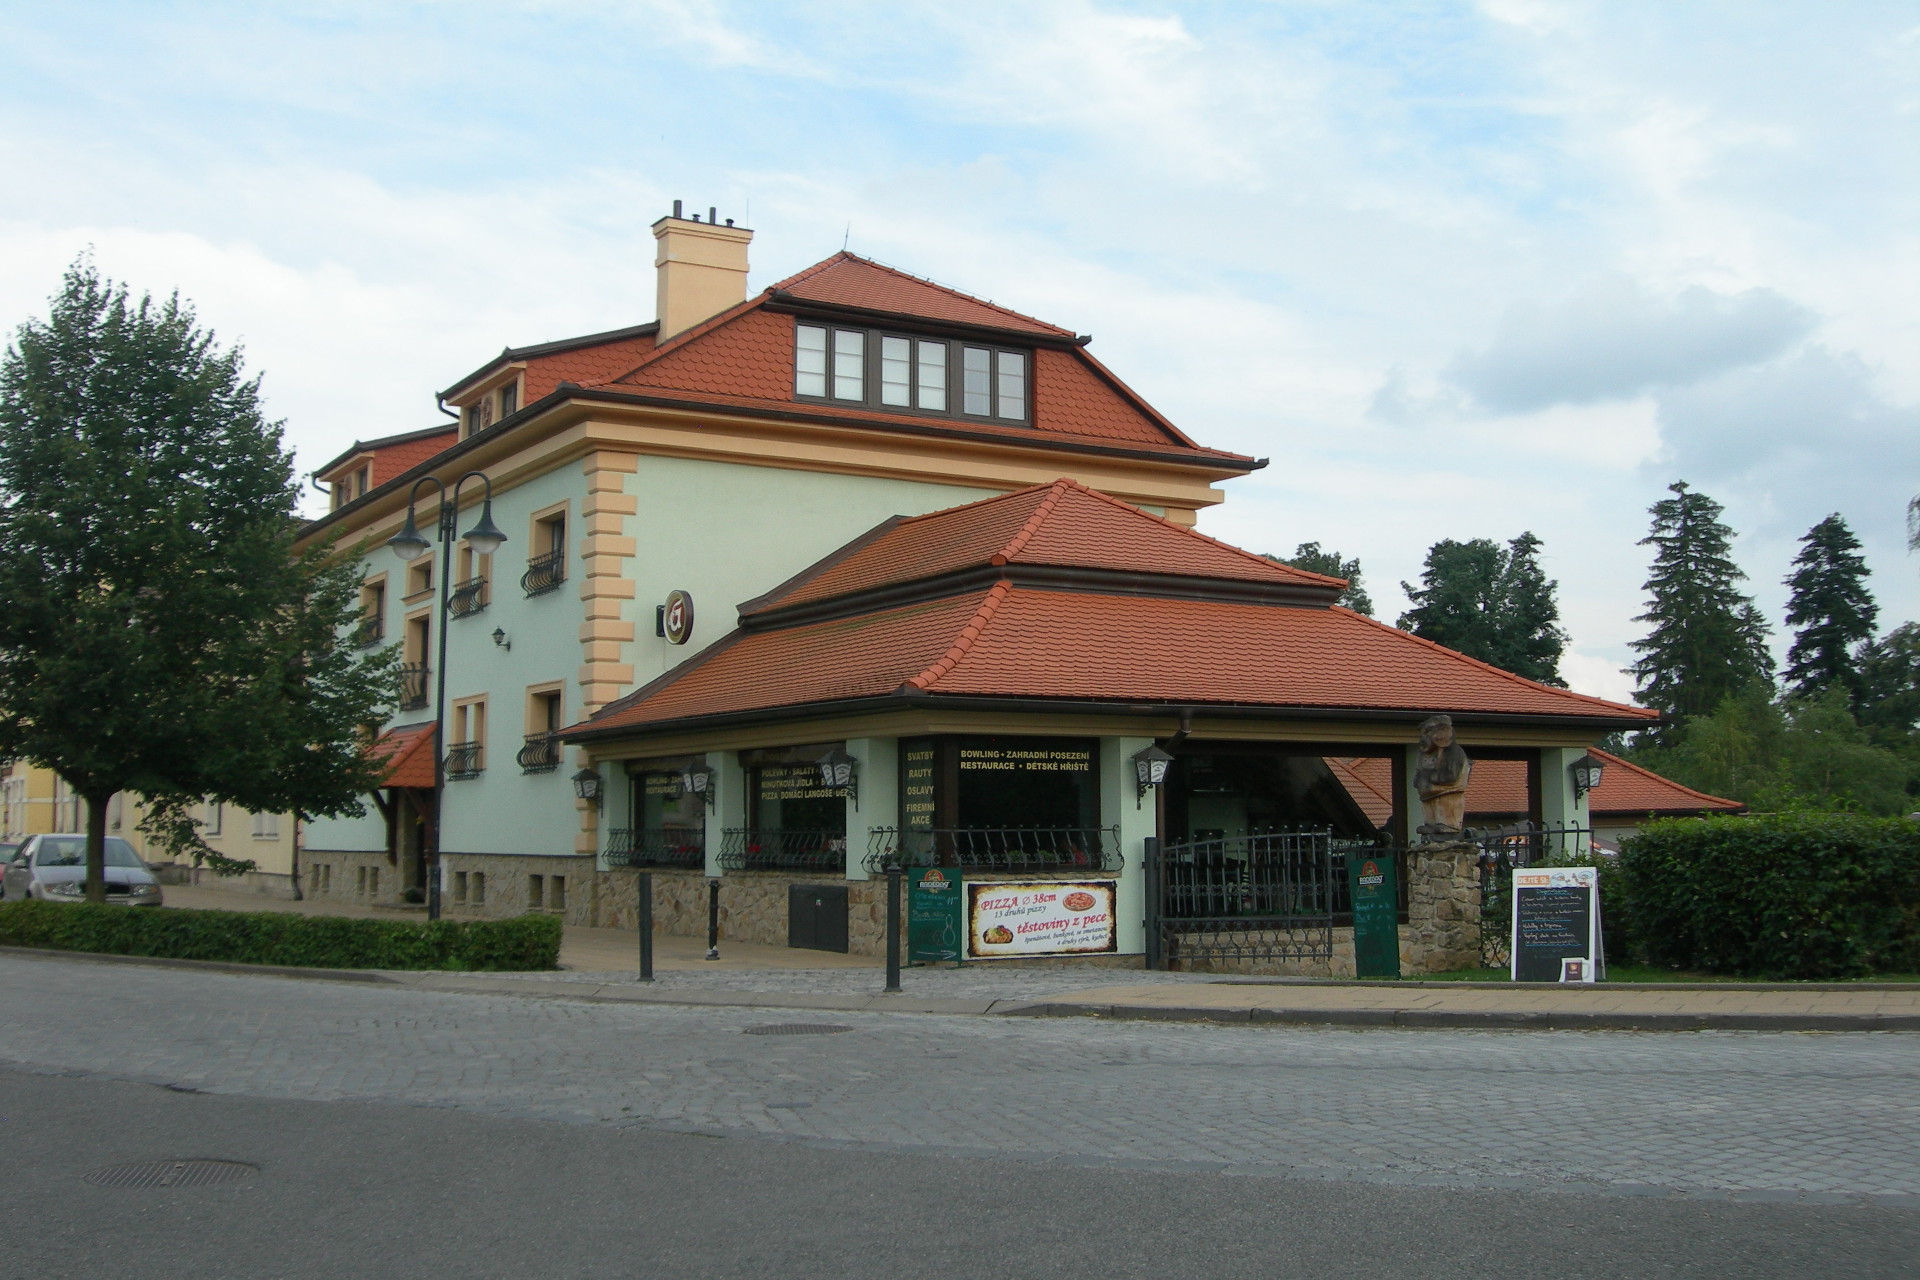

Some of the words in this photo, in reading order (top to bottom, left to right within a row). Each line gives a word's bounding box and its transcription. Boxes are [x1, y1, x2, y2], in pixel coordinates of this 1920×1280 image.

[907, 751, 934, 761] SVATBY
[960, 750, 1000, 759] BOWLING
[1006, 750, 1048, 760] ZAHRADNÍ
[1050, 751, 1090, 760] POSEZENÍ
[960, 761, 1015, 770] RESTAURACE
[908, 768, 932, 778] RAUTY
[907, 785, 934, 796] OSLAVY
[906, 801, 935, 813] FIREMNÍ
[911, 815, 930, 825] AKCE
[980, 896, 1019, 911] PIZZA
[1032, 893, 1057, 904] 38cm
[994, 911, 1003, 919] 13
[1004, 906, 1026, 917] druhů
[1026, 904, 1047, 917] pizzy
[1016, 916, 1070, 935] těstoviny
[1072, 916, 1080, 926] z
[1082, 913, 1107, 929] pece
